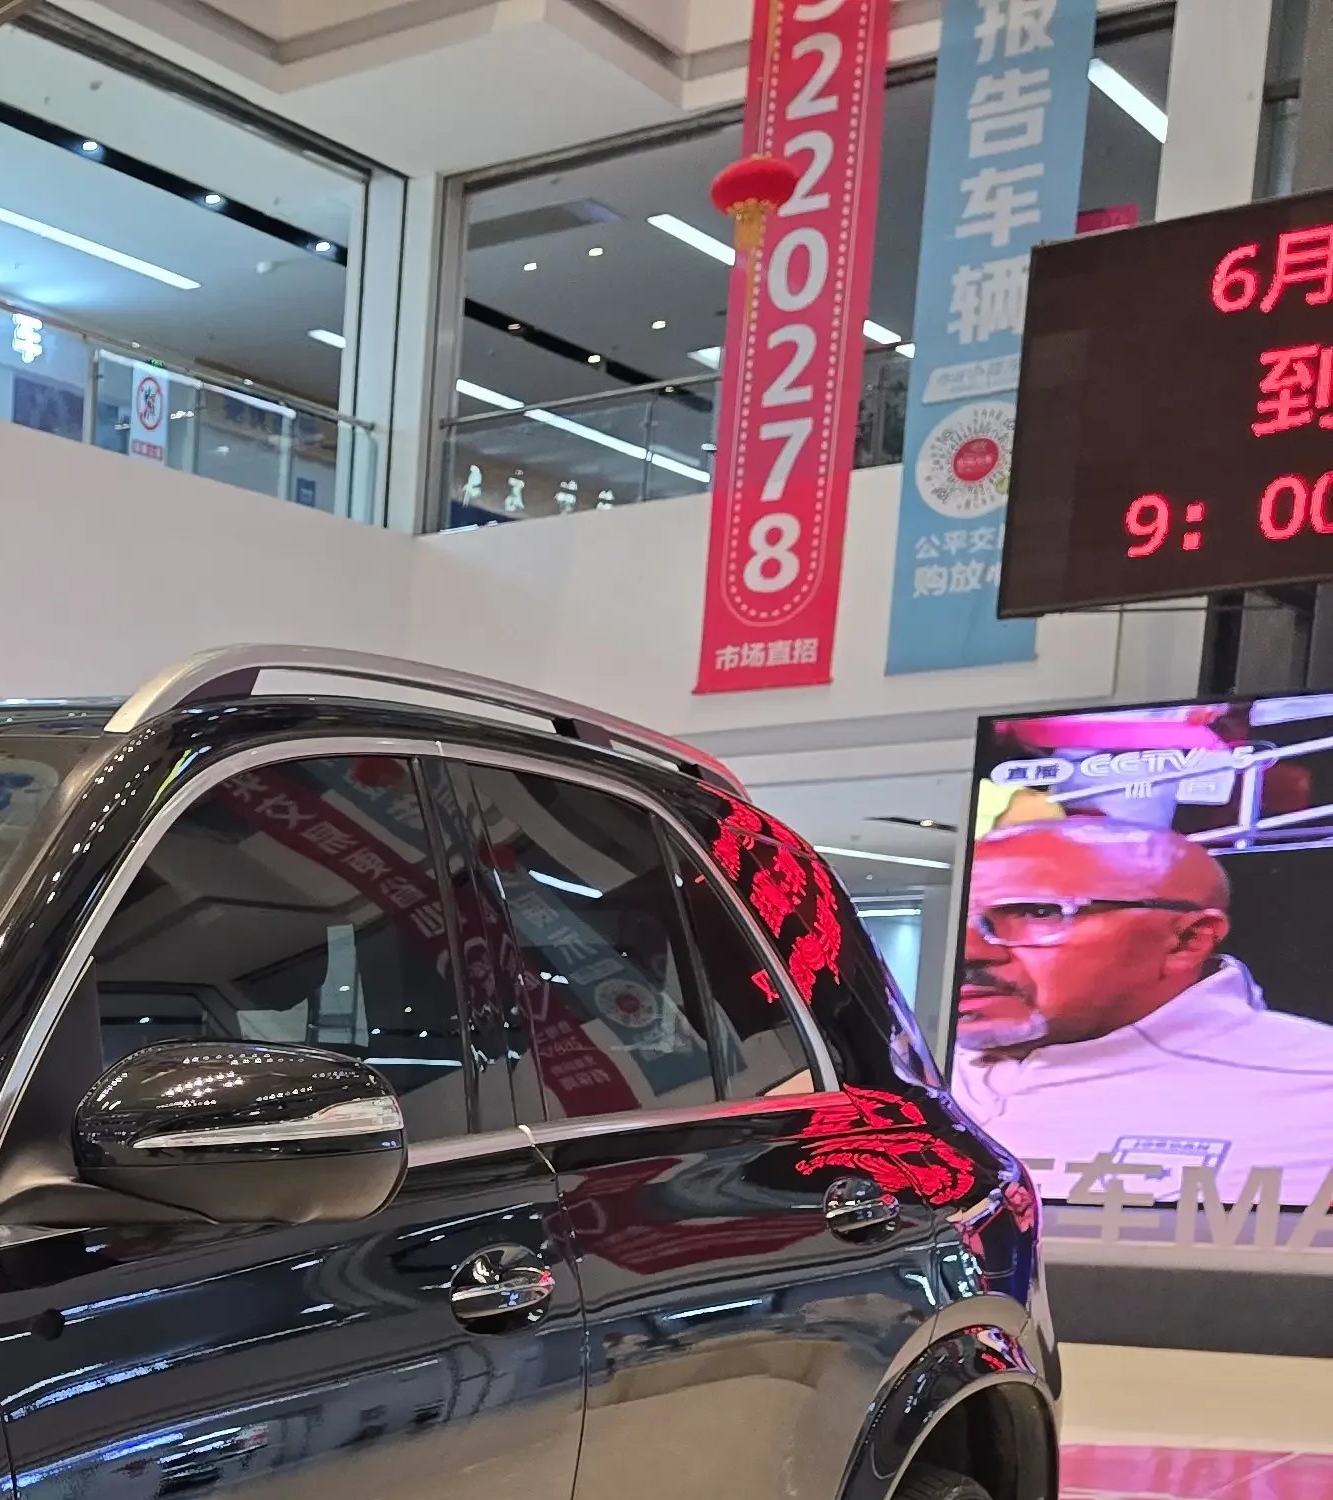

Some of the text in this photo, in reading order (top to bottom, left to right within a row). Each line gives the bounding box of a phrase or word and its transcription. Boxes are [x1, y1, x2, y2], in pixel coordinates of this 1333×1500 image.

[946, 0, 1054, 345] 报告车辆
[742, 0, 843, 594] 220278
[1210, 223, 1333, 314] 6月
[1250, 343, 1333, 438] 到
[915, 523, 1004, 560] 公平交
[714, 637, 820, 672] 市场直招
